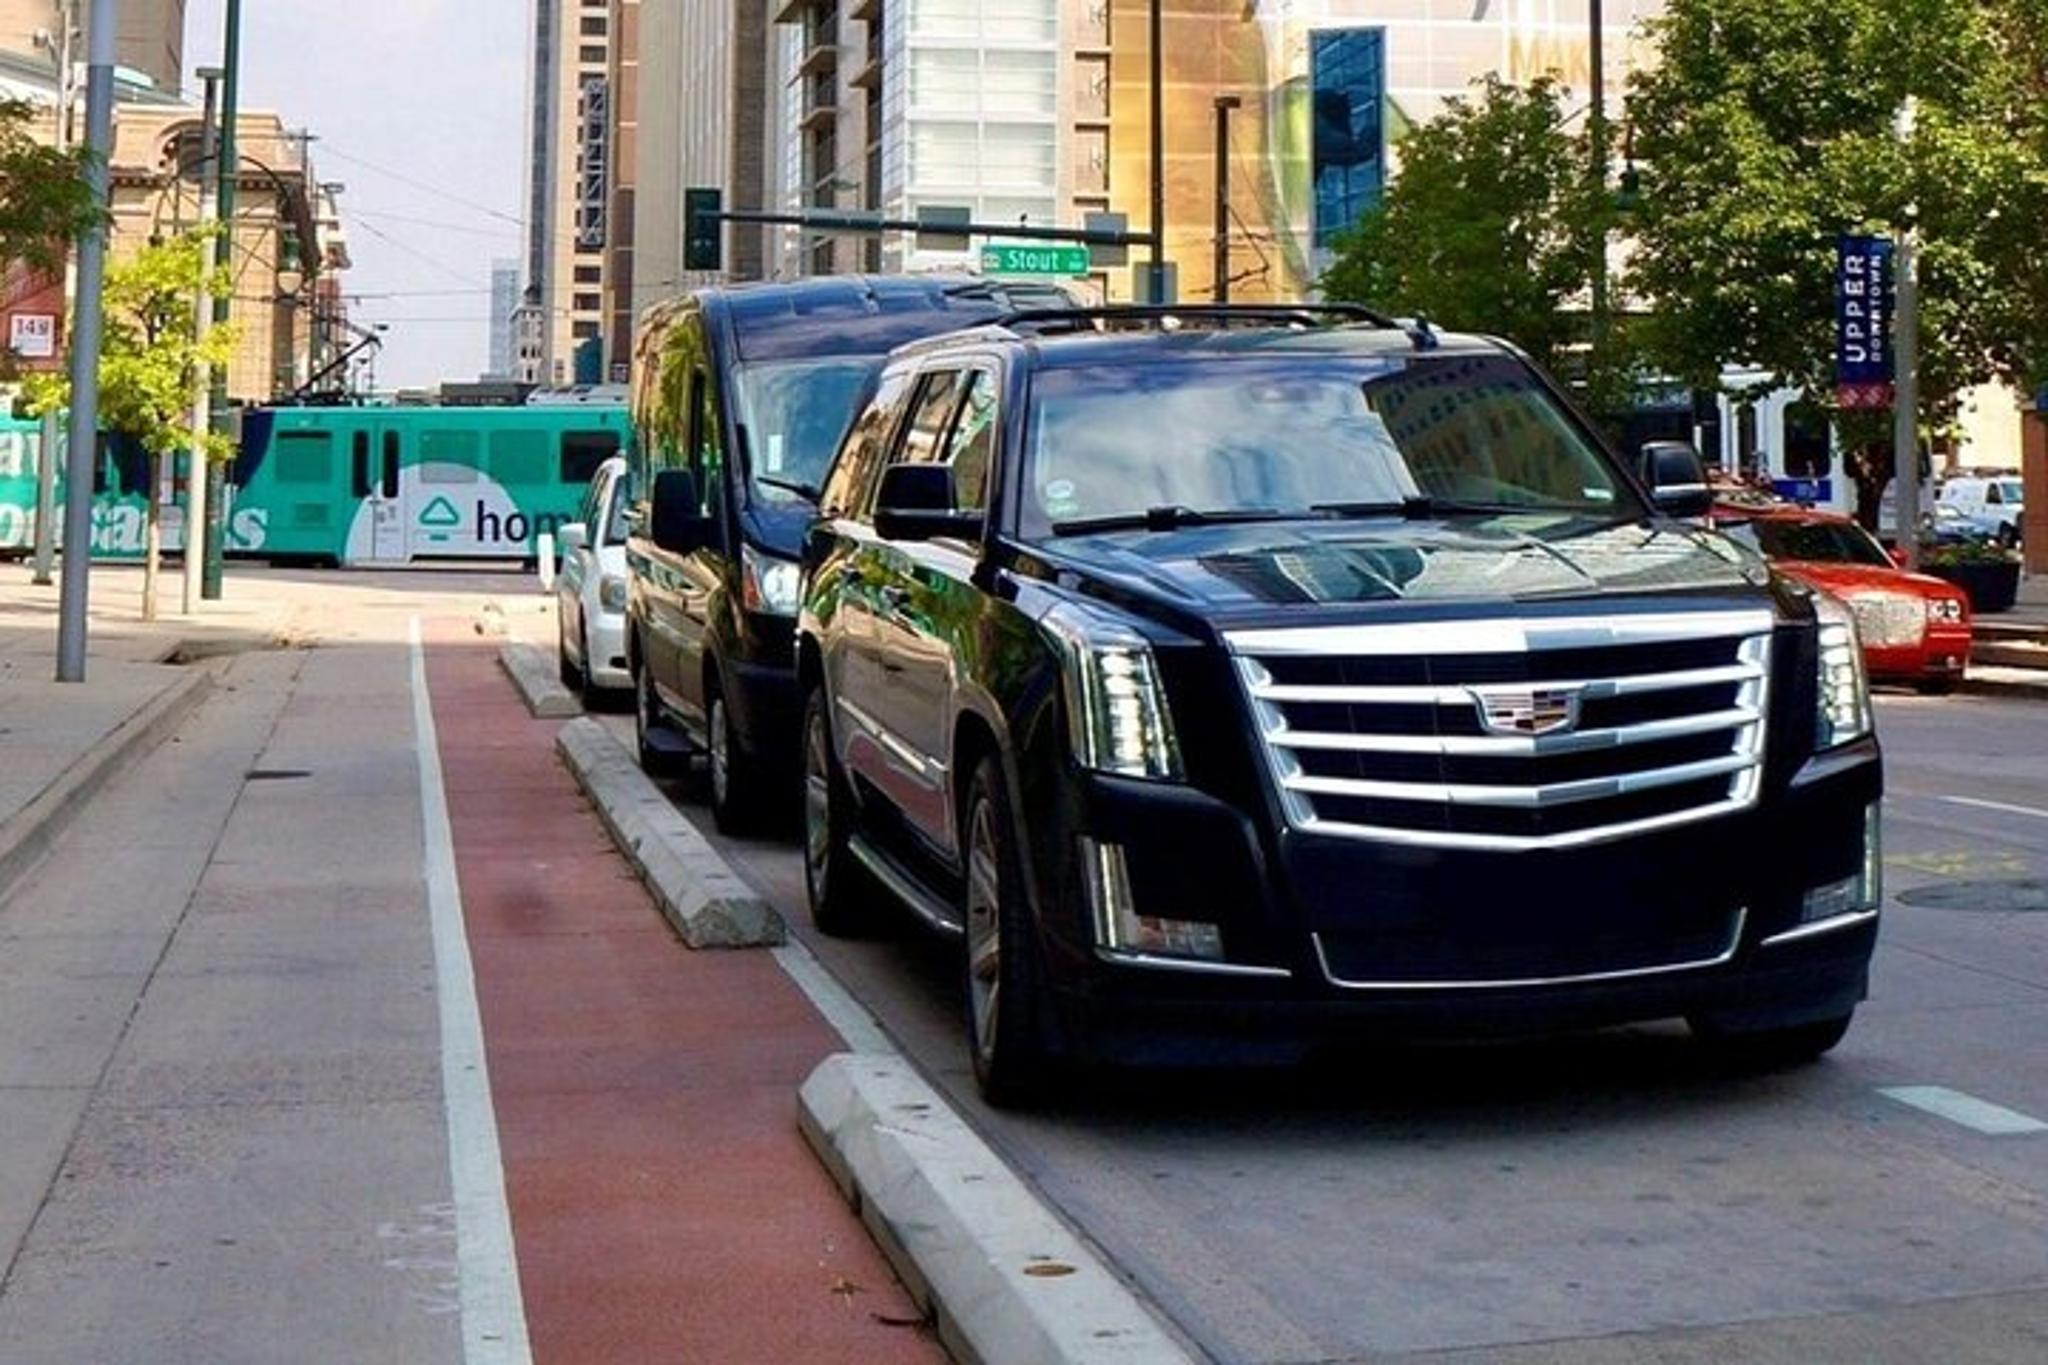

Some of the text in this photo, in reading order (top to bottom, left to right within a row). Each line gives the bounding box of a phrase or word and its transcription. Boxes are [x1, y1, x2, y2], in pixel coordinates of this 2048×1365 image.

[1007, 250, 1059, 270] Stout
[1845, 254, 1868, 363] UPPER
[1869, 254, 1882, 363] DOWNTOWN
